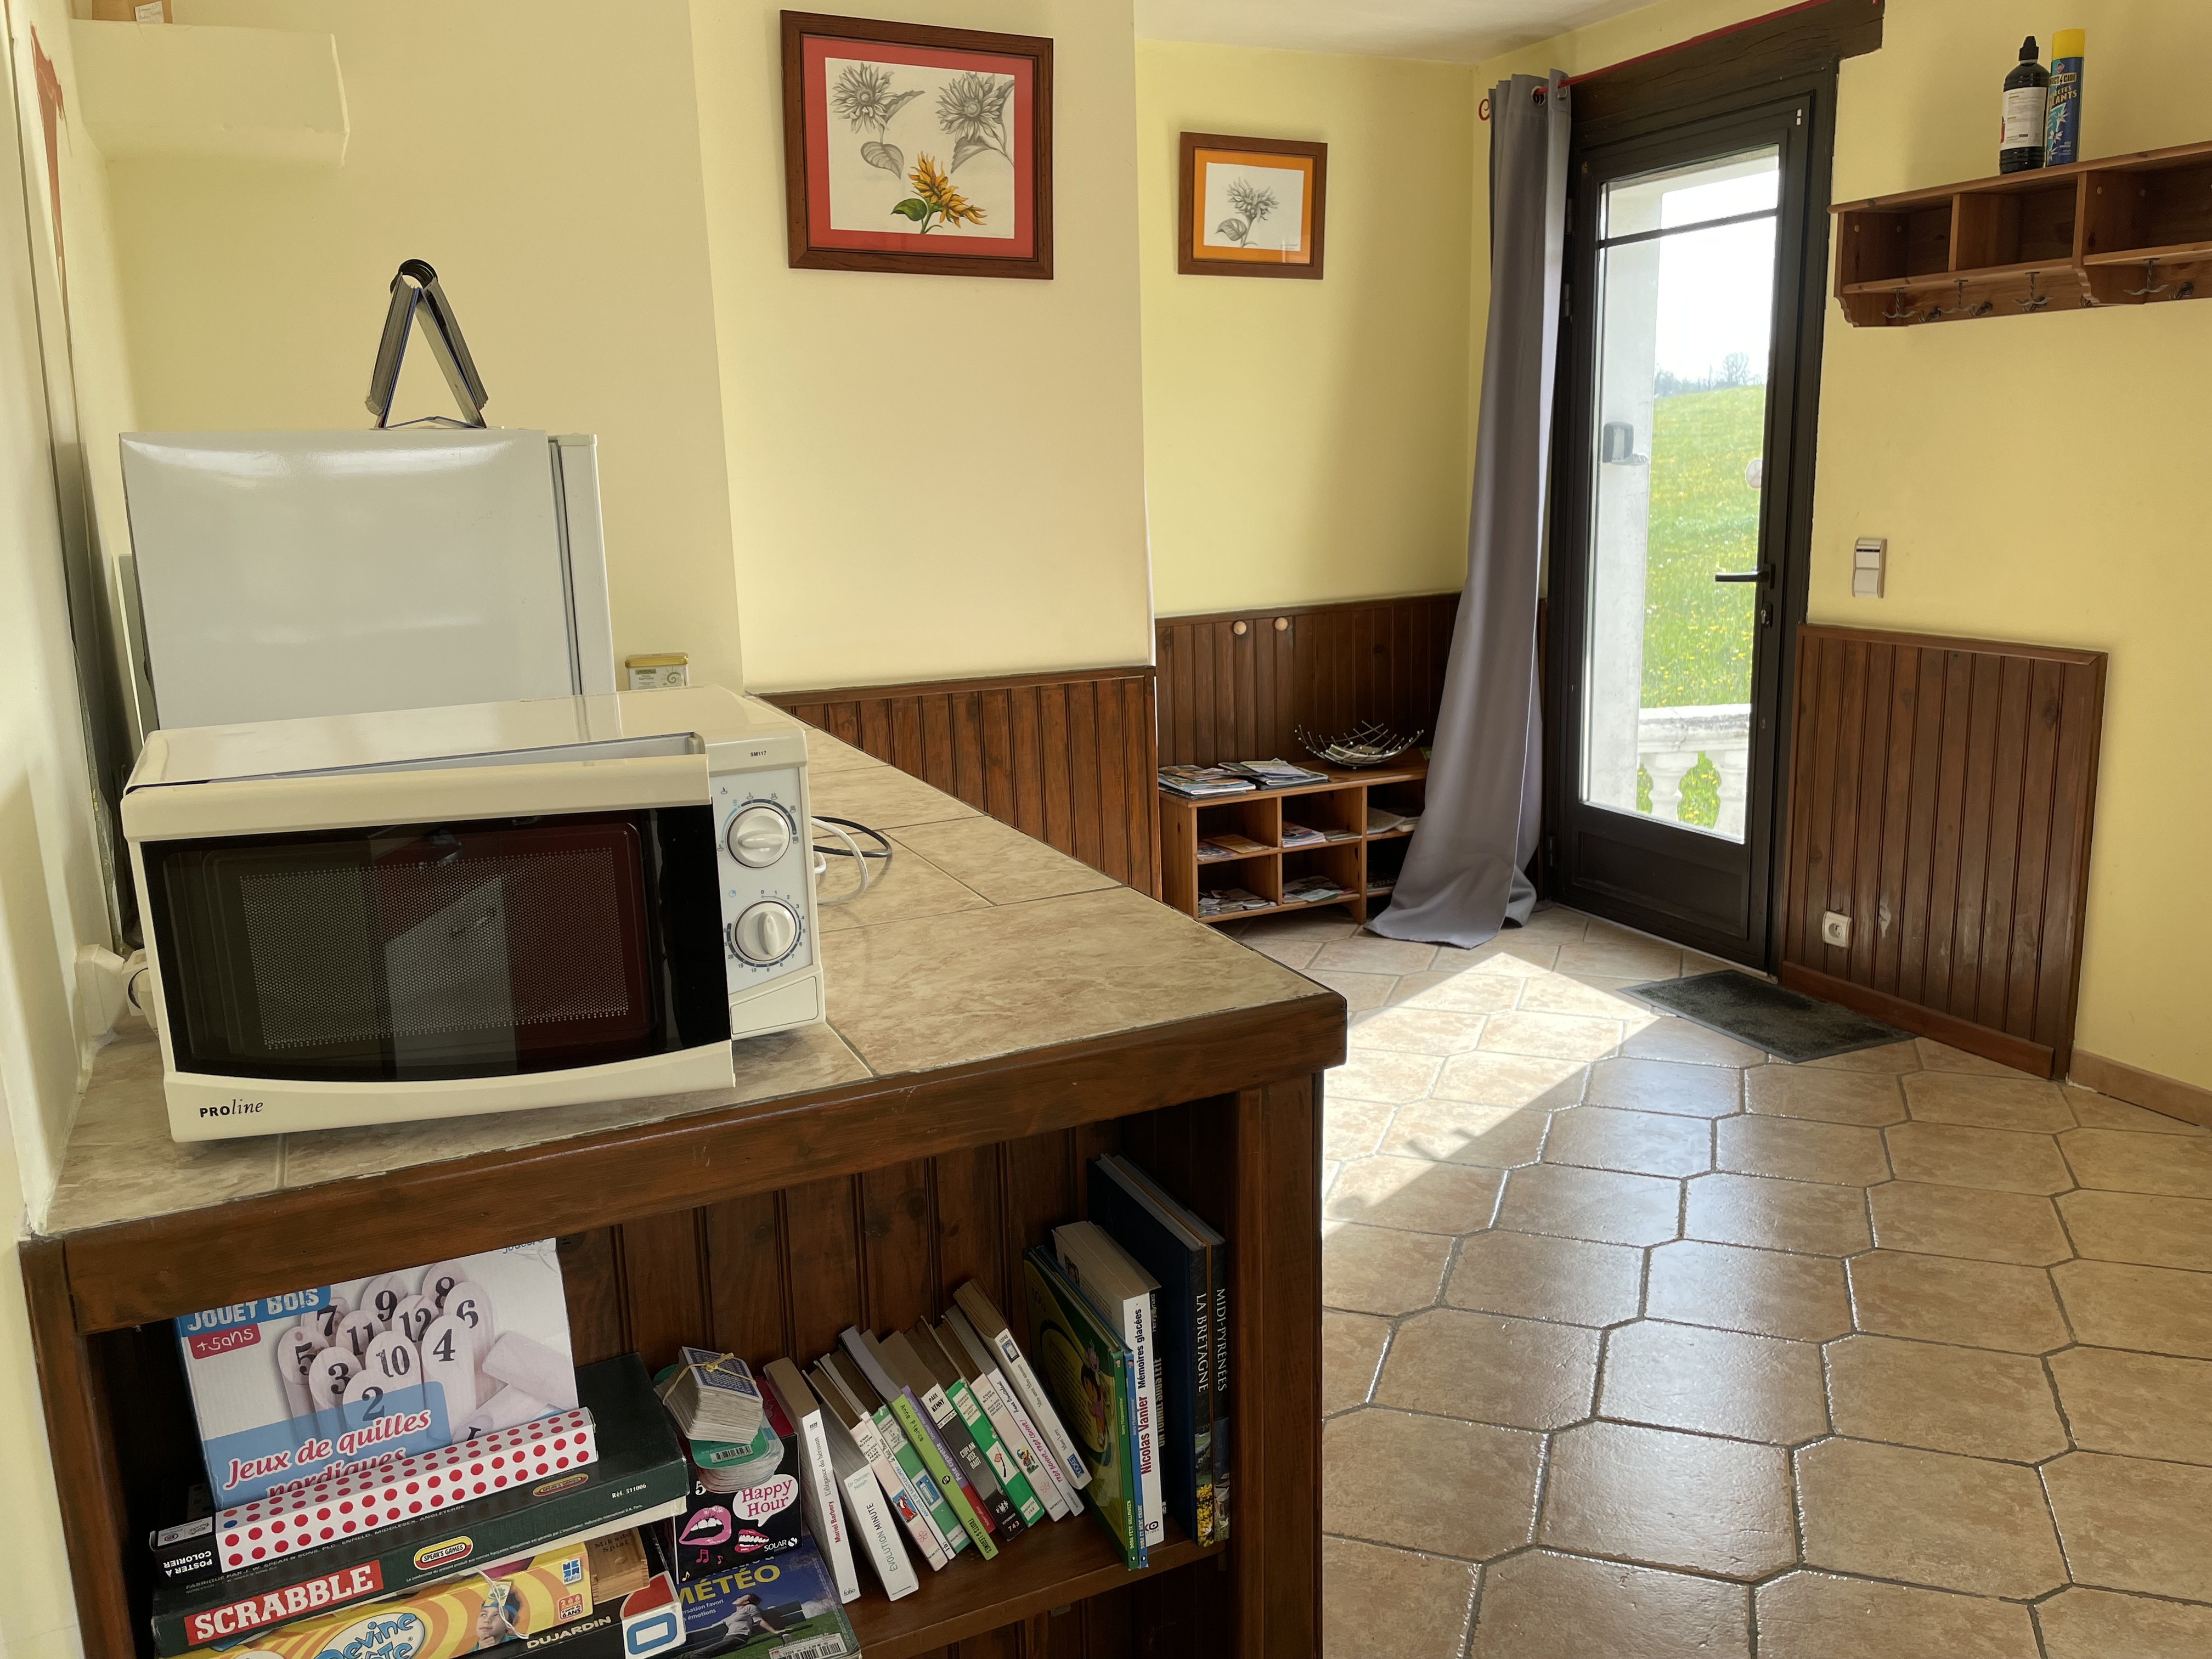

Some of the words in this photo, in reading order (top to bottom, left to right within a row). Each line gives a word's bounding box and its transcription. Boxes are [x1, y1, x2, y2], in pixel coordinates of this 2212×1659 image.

[200, 1099, 263, 1118] PROline
[435, 1277, 455, 1309] 8
[1196, 1293, 1206, 1312] LA
[188, 1300, 258, 1331] JOUET
[266, 1288, 320, 1315] BOIS
[375, 1290, 398, 1322] 9
[456, 1300, 479, 1329] 6
[317, 1305, 338, 1337] 7
[399, 1308, 431, 1343] 12
[1134, 1308, 1145, 1343] glacées
[347, 1322, 375, 1356] 11
[433, 1329, 456, 1362] 4
[1216, 1288, 1228, 1392] MIDI-PYRÉNÉES
[295, 1342, 317, 1376] 5
[376, 1346, 410, 1378] 10
[1197, 1315, 1209, 1393] BRETAGNE
[1016, 1363, 1028, 1379] amours
[1137, 1345, 1146, 1390] Mémoires
[328, 1362, 351, 1395] 3
[1024, 1378, 1032, 1389] Mes
[1029, 1387, 1038, 1398] amis
[1035, 1397, 1043, 1407] Mes
[362, 1386, 386, 1421] 2
[930, 1398, 946, 1412] KENNY
[1008, 1401, 1019, 1414] Anne
[900, 1403, 912, 1419] Anne
[909, 1420, 925, 1442] Pierce
[1137, 1396, 1149, 1432] Vanier
[1053, 1427, 1063, 1440] Levy
[225, 1452, 290, 1488] Jeux
[298, 1441, 330, 1463] de
[339, 1411, 430, 1454] quilles
[812, 1436, 823, 1459] hérisson
[958, 1441, 977, 1458] COPLAN
[1032, 1437, 1044, 1452] TROP
[1058, 1438, 1068, 1451] Marc
[1139, 1433, 1152, 1475] Nicolas
[818, 1459, 825, 1468] du
[935, 1441, 955, 1468] cigarette
[966, 1450, 978, 1462] VISE
[968, 1456, 983, 1469] HAUT
[950, 1466, 962, 1481] Pose
[1067, 1454, 1084, 1477] POCKET
[819, 1468, 832, 1496] L'élégance
[848, 1480, 854, 1488] Dr
[853, 1472, 870, 1485] Darren
[854, 1479, 868, 1491] Naish
[1052, 1469, 1064, 1483] TROP
[612, 1490, 624, 1498] Réf.
[626, 1483, 647, 1494] 511006
[742, 1479, 793, 1503] Happy
[747, 1497, 789, 1518] Hour
[826, 1500, 838, 1523] Barbery
[866, 1502, 882, 1530] MINUTE
[915, 1498, 929, 1517] ANTOINE
[831, 1524, 841, 1543] Muriel
[967, 1517, 980, 1533] FRUITS
[1007, 1520, 1020, 1532] 743
[594, 1532, 633, 1548] Mikado
[602, 1539, 629, 1553] Spiel
[764, 1540, 787, 1552] SOLAR
[162, 1550, 212, 1569] COLORIER
[424, 1548, 444, 1561] SPEAR'S
[445, 1543, 464, 1556] GAMES
[875, 1530, 899, 1572] ÉVOLUTION
[175, 1558, 213, 1575] POSTER
[195, 1565, 374, 1639] SCRABBLE
[843, 1588, 856, 1597] folio
[567, 1608, 581, 1616] ANS
[706, 1599, 724, 1610] favori
[687, 1609, 716, 1621] émotions
[527, 1616, 612, 1649] DUJARDIN
